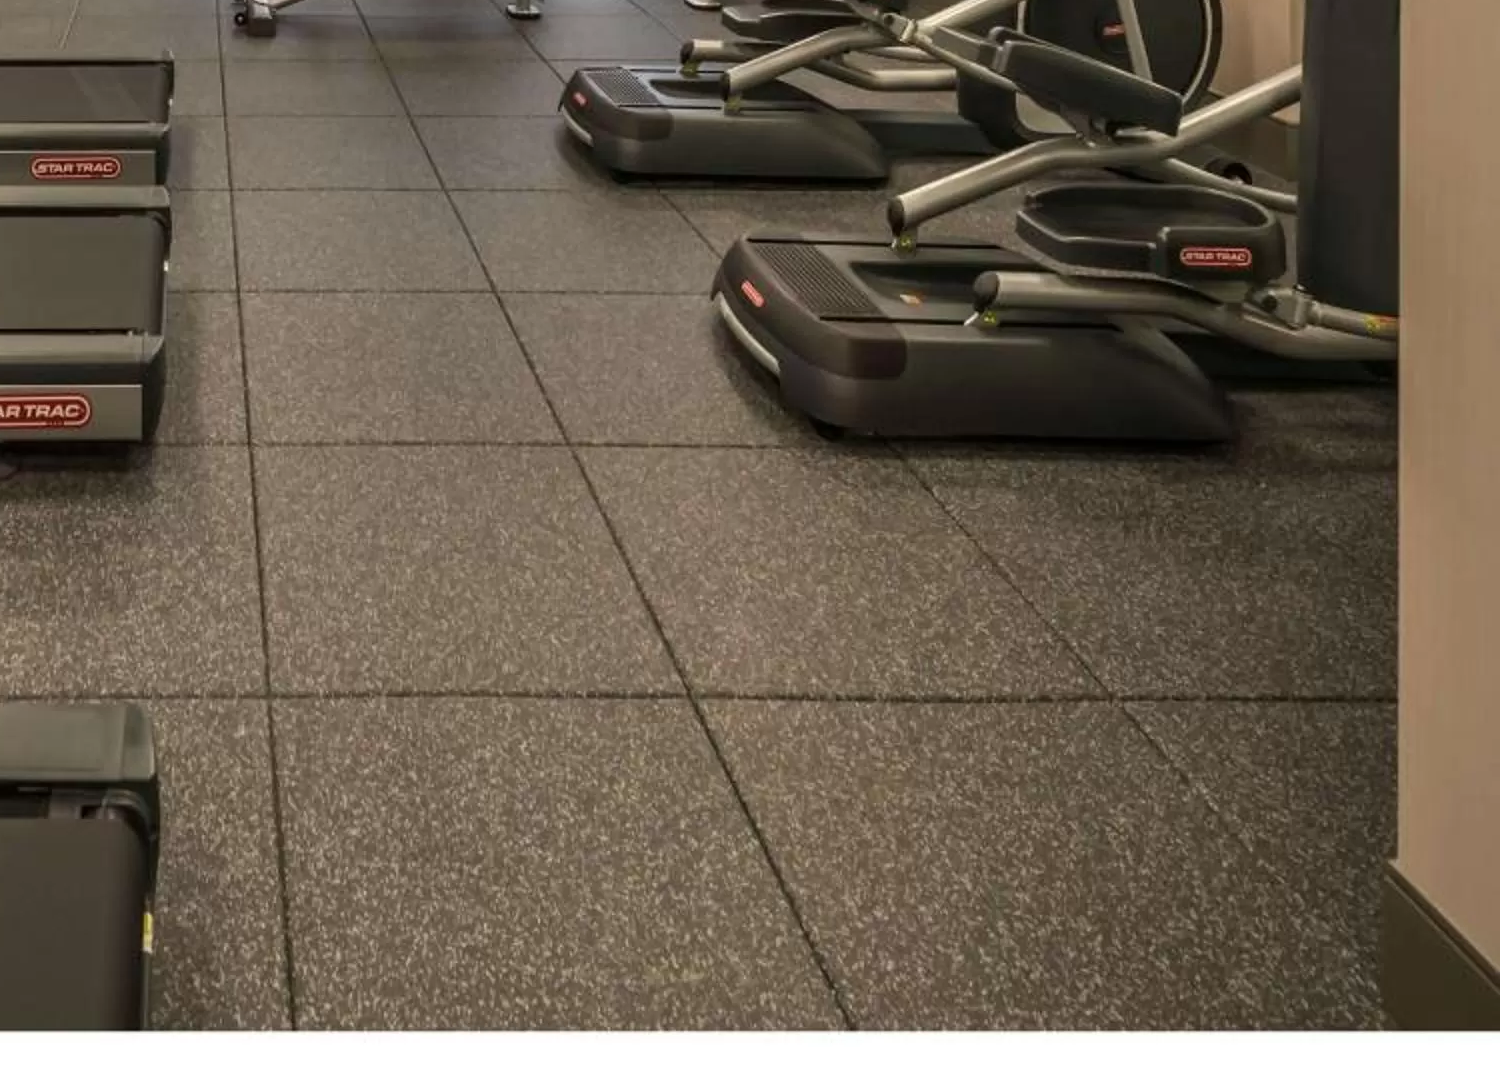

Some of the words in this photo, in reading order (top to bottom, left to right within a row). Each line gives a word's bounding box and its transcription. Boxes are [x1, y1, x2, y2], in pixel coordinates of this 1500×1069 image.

[37, 163, 74, 174] STAR
[75, 162, 114, 173] TRAC
[23, 404, 80, 418] TRAC
